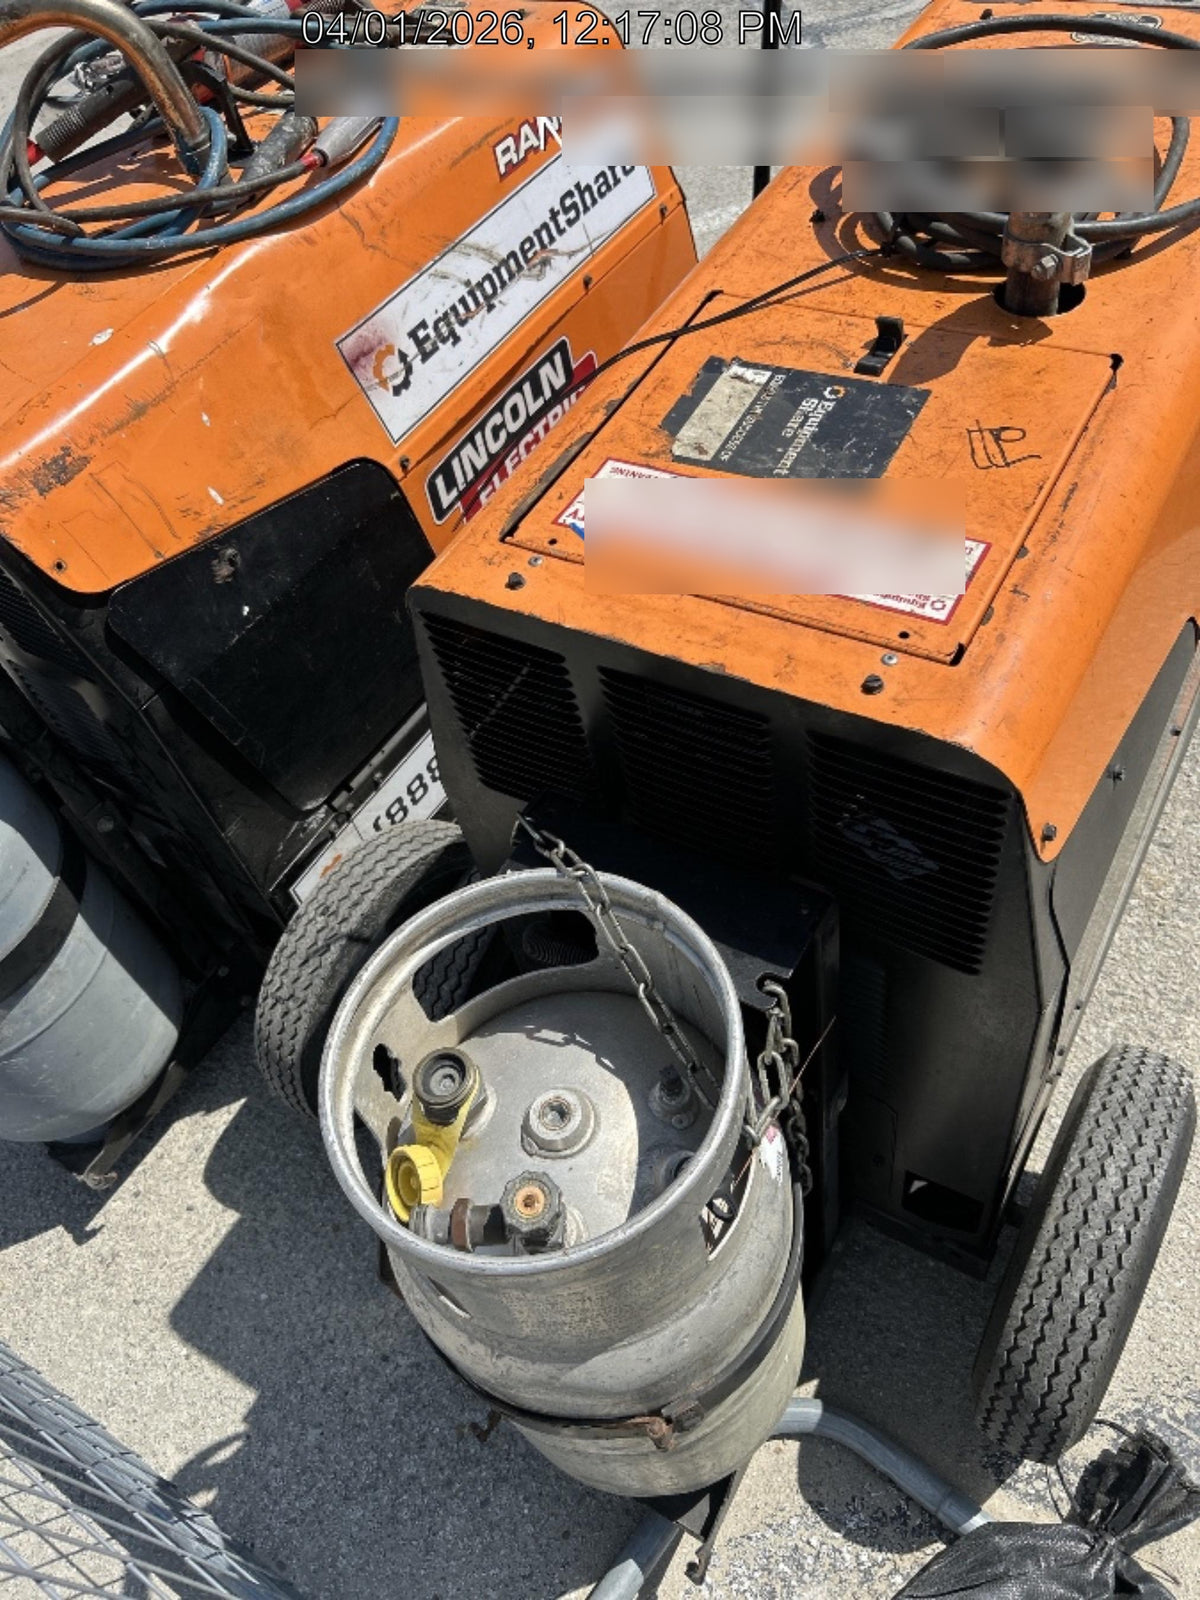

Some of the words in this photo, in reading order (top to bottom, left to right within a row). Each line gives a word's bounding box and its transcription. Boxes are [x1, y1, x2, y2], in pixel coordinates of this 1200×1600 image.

[434, 351, 566, 509] LINCOLN
[773, 400, 837, 476] Equipment
[781, 398, 819, 438] Share
